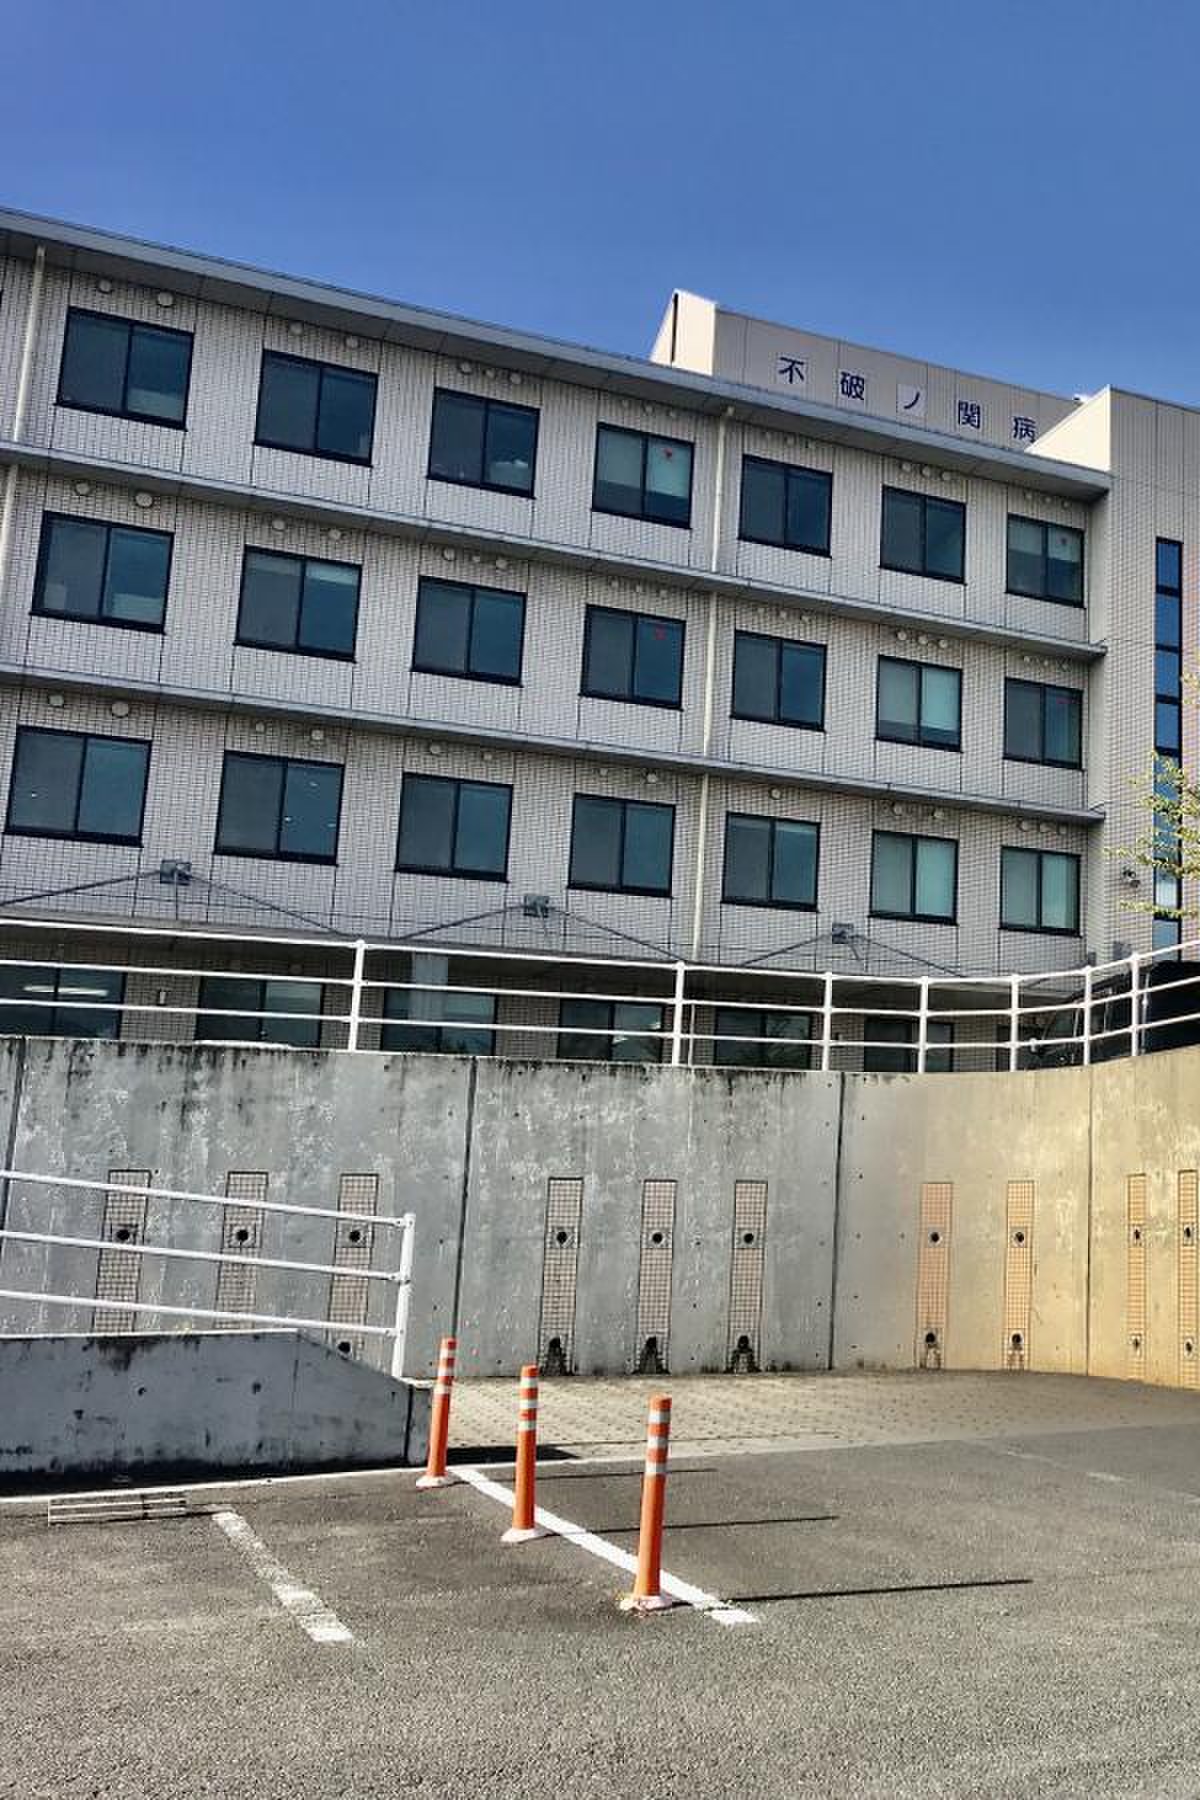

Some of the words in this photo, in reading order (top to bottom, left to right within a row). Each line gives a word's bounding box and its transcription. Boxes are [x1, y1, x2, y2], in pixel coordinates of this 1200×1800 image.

[778, 356, 1036, 444] 不破ノ関病
